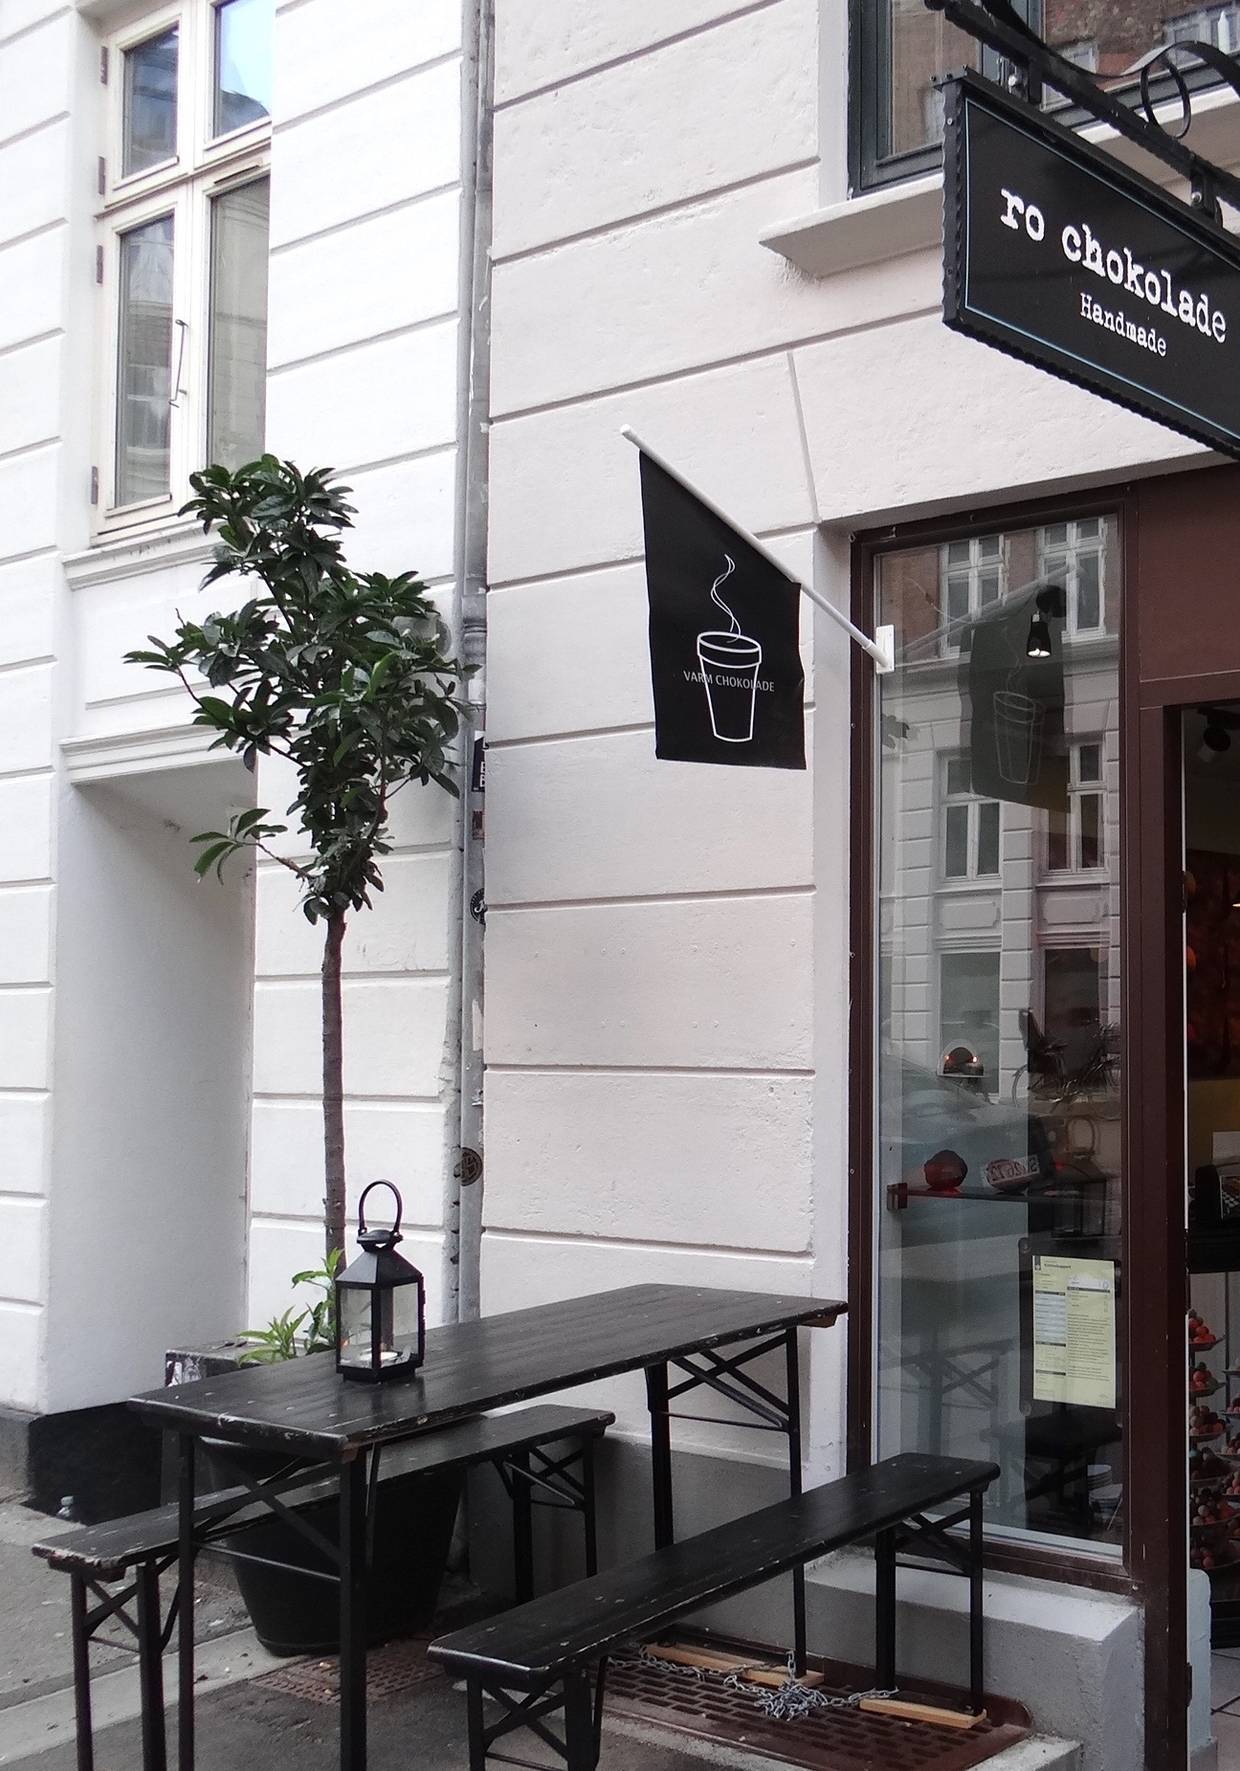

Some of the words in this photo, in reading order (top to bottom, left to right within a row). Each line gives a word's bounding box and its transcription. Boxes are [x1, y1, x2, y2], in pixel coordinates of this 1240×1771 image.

[999, 188, 1045, 242] ro
[1061, 224, 1227, 344] chokolade
[1080, 293, 1168, 357] Handmade
[683, 670, 713, 684] VARM
[716, 675, 774, 692] CHOKOLADE
